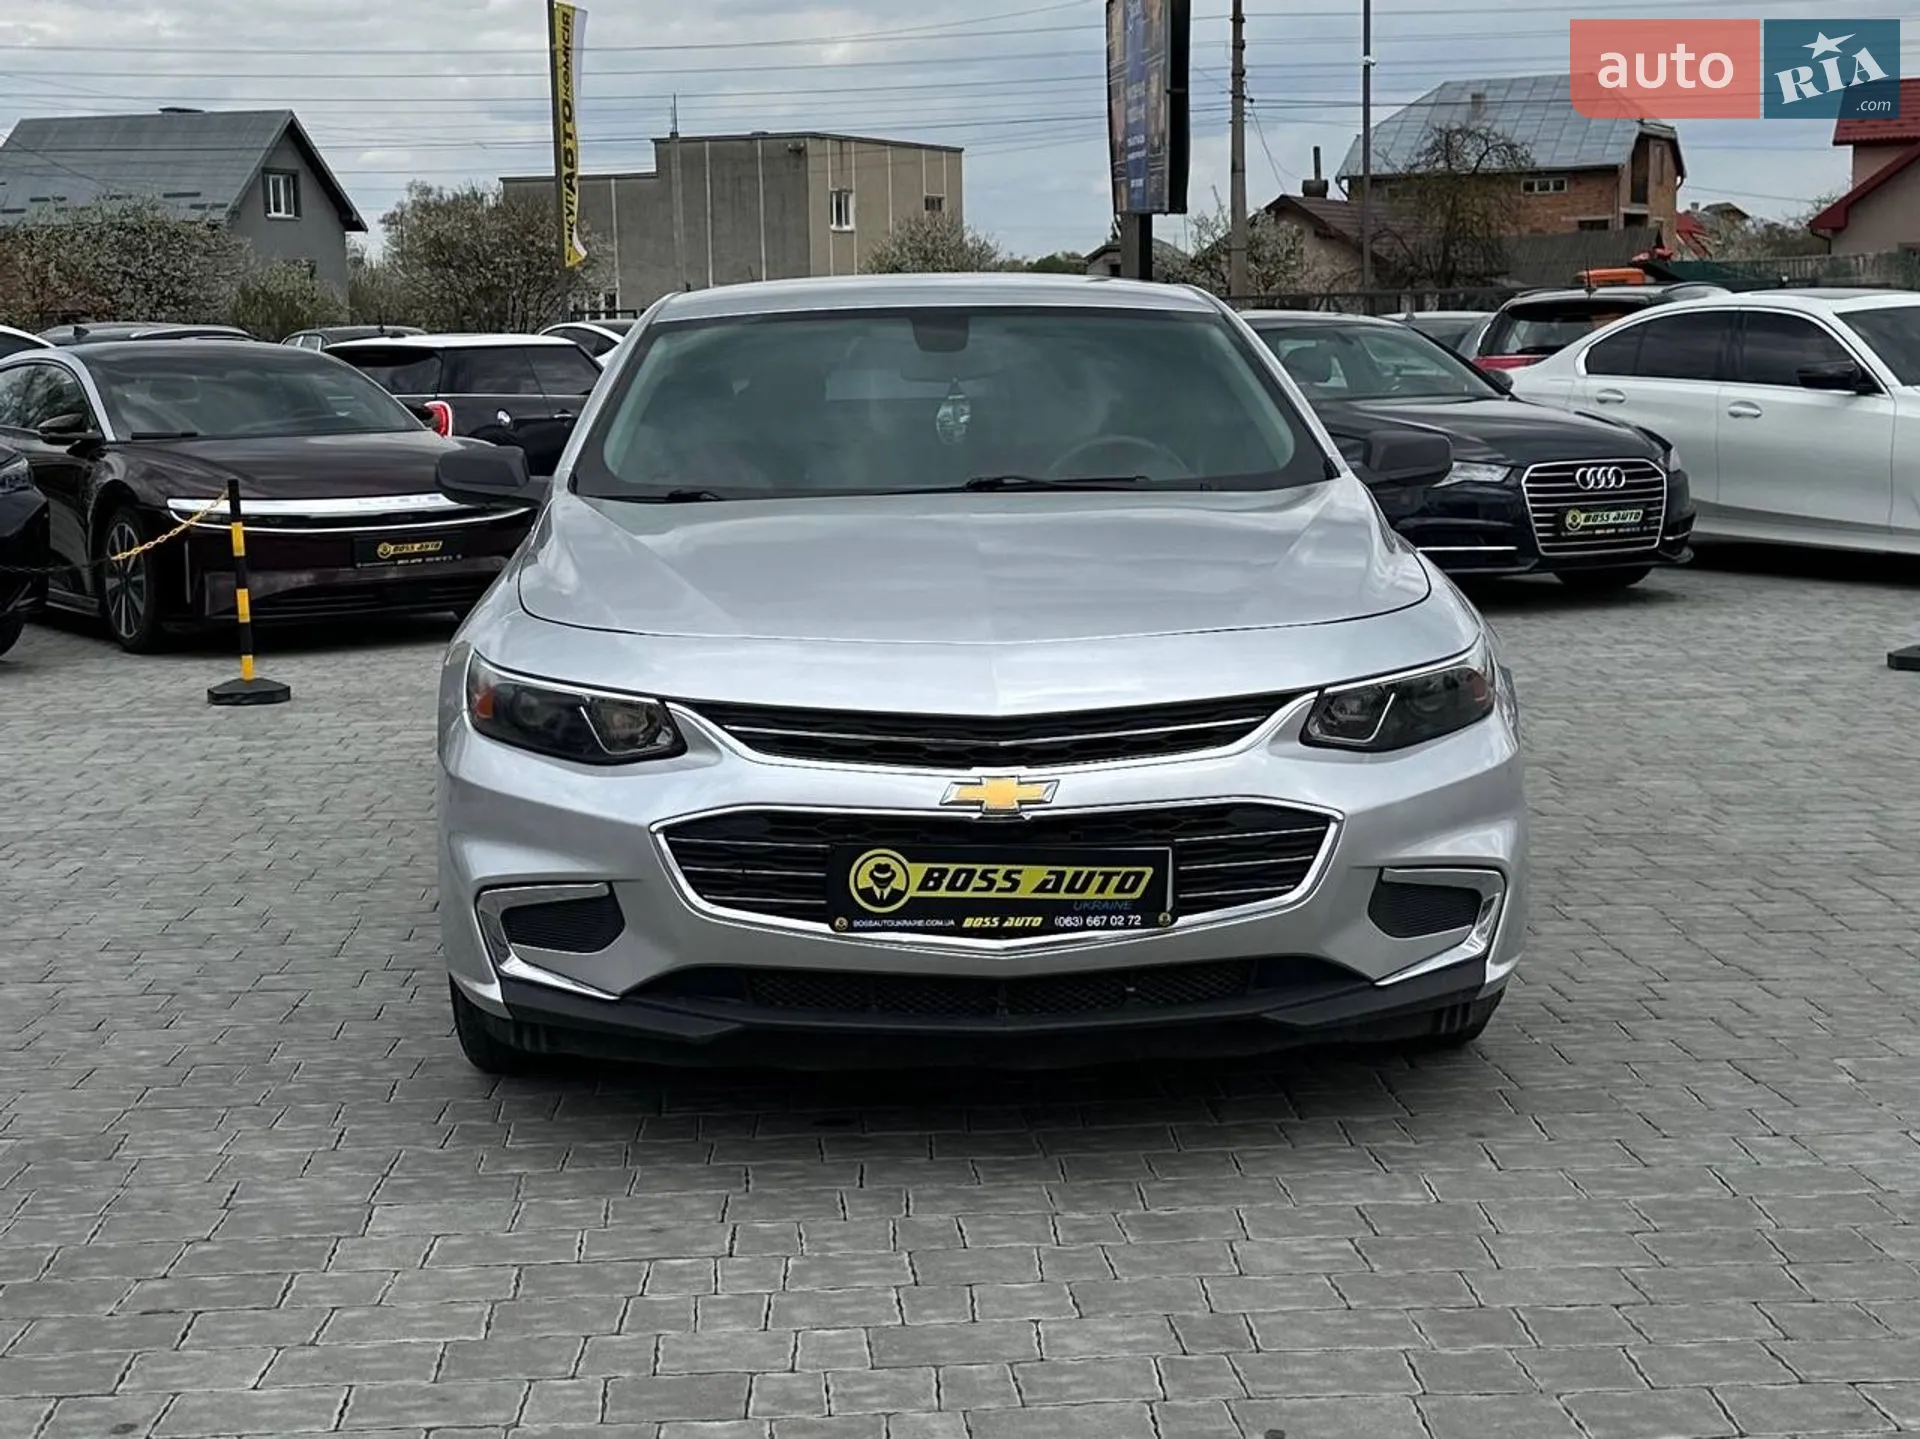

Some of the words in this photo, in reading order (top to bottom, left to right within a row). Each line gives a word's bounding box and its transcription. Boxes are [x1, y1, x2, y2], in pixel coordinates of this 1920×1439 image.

[916, 867, 1024, 894] BOSS
[1030, 869, 1147, 894] AUTO
[1072, 901, 1133, 911] UKRAINE
[962, 916, 1000, 928] BOSS
[1002, 916, 1044, 927] AUTO
[1086, 915, 1108, 927] 667
[1110, 915, 1125, 926] 02
[1127, 914, 1142, 926] 72
